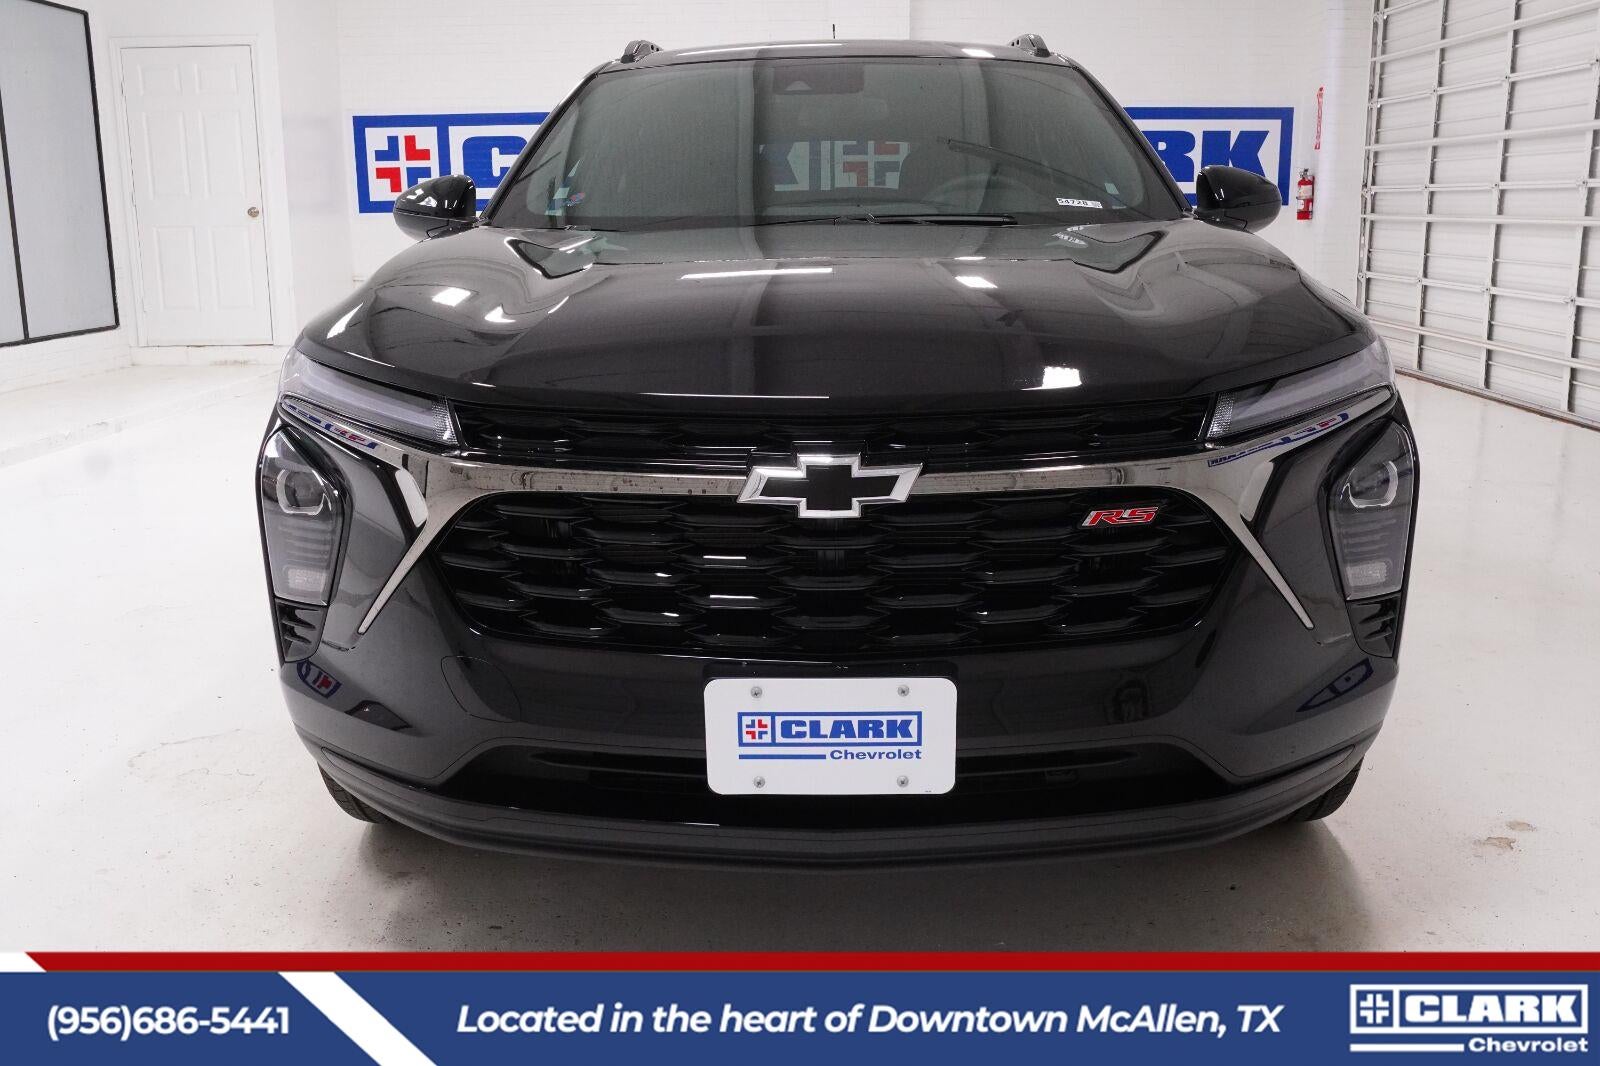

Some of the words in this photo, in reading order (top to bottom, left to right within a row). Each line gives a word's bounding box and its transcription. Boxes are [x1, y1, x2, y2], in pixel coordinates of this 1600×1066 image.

[1082, 506, 1158, 526] RS
[780, 719, 913, 739] CLARK
[829, 748, 922, 760] Chevrolet
